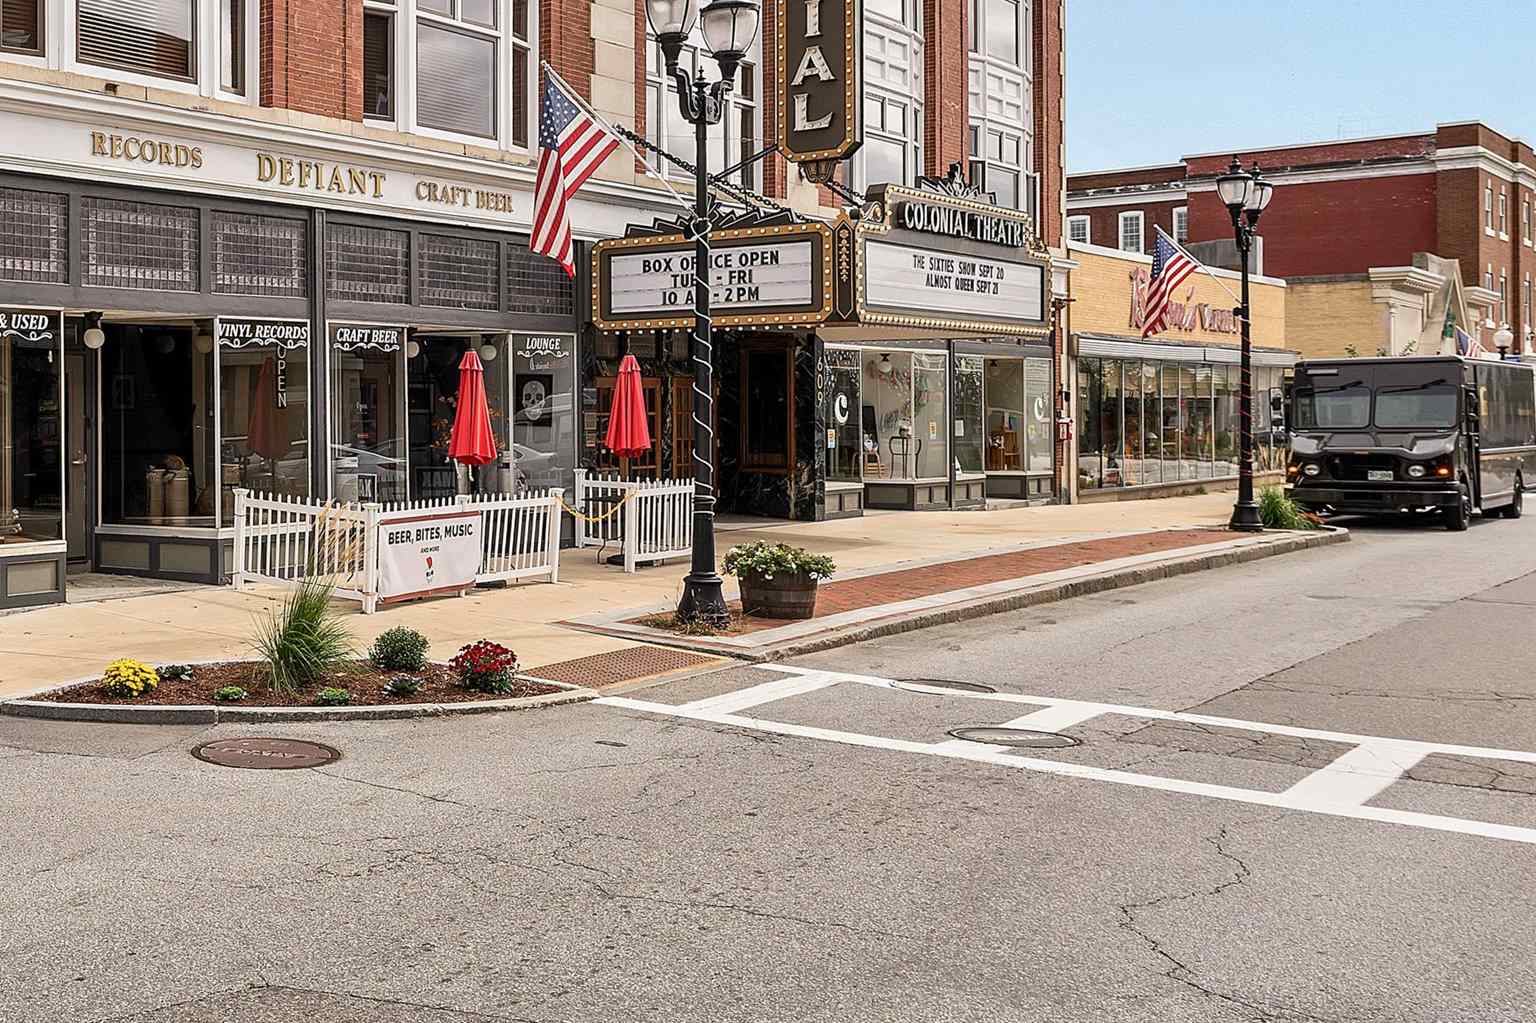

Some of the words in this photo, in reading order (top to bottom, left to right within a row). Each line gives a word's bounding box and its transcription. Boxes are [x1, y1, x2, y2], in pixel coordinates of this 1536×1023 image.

[91, 131, 203, 169] RECORDS
[256, 152, 386, 198] DEFIANT
[416, 181, 472, 207] CRAFT
[476, 190, 514, 213] BEER
[904, 202, 975, 238] COLONIAL
[974, 215, 1025, 247] THEATR
[642, 258, 672, 273] BOX
[680, 254, 732, 271] OFICE
[738, 250, 779, 267] OPEN
[913, 255, 925, 269] THE
[929, 257, 954, 273] SIXTIES
[958, 261, 976, 276] SHOW
[979, 264, 994, 278] SEPT
[996, 266, 1005, 280] 20
[728, 269, 753, 285] FRI
[925, 273, 952, 289] ALMOST
[955, 277, 974, 292] QUEEN
[976, 280, 991, 294] SEPT
[662, 291, 678, 305] 10
[685, 290, 696, 304] A
[11, 314, 49, 330] USED
[219, 323, 255, 338] VINYL
[255, 324, 308, 339] RECORDS
[336, 328, 370, 343] CRAFT
[371, 329, 398, 344] BEER
[526, 337, 561, 350] LOUNGE
[277, 346, 287, 408] OPEN
[388, 530, 414, 545] BEER,
[416, 526, 442, 542] BITES,
[444, 523, 473, 538] MUSIC
